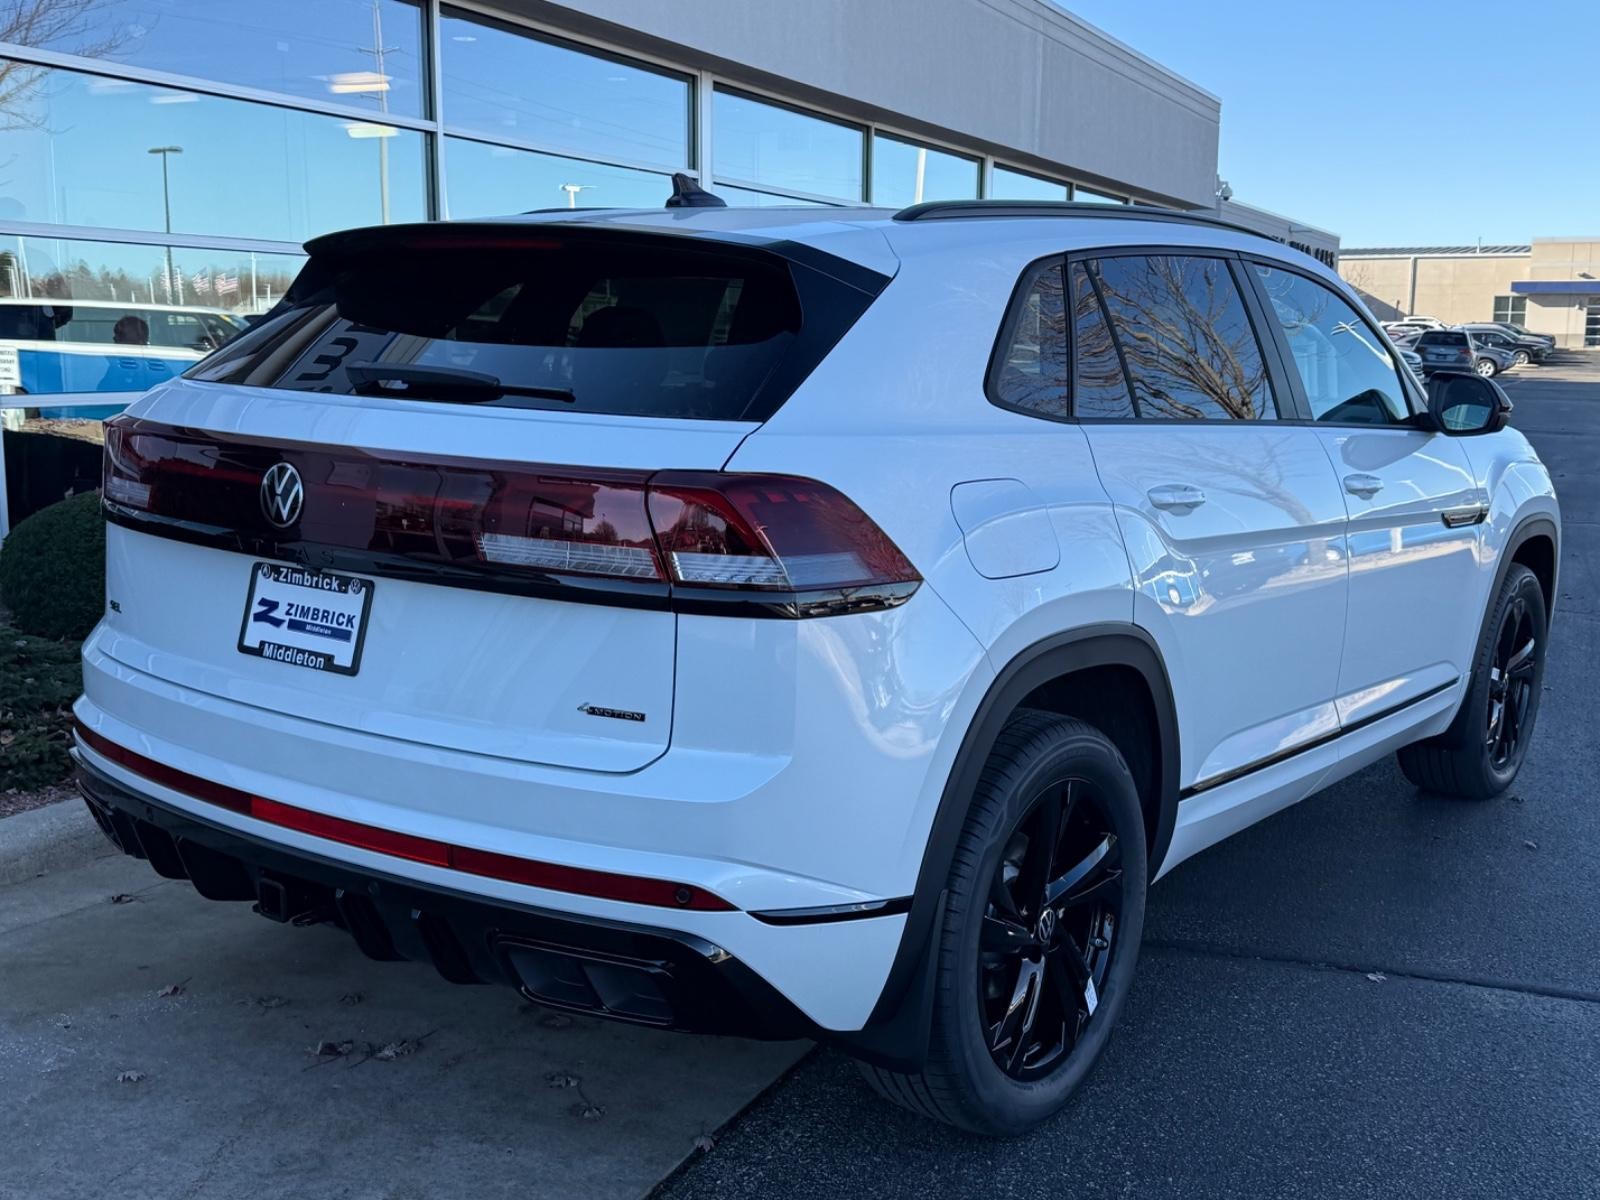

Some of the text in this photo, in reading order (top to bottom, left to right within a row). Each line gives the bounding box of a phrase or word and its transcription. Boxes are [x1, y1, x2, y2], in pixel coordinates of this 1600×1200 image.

[279, 567, 340, 592] Zimbrick
[285, 602, 356, 629] ZIMBRICK
[262, 642, 326, 669] Middleton
